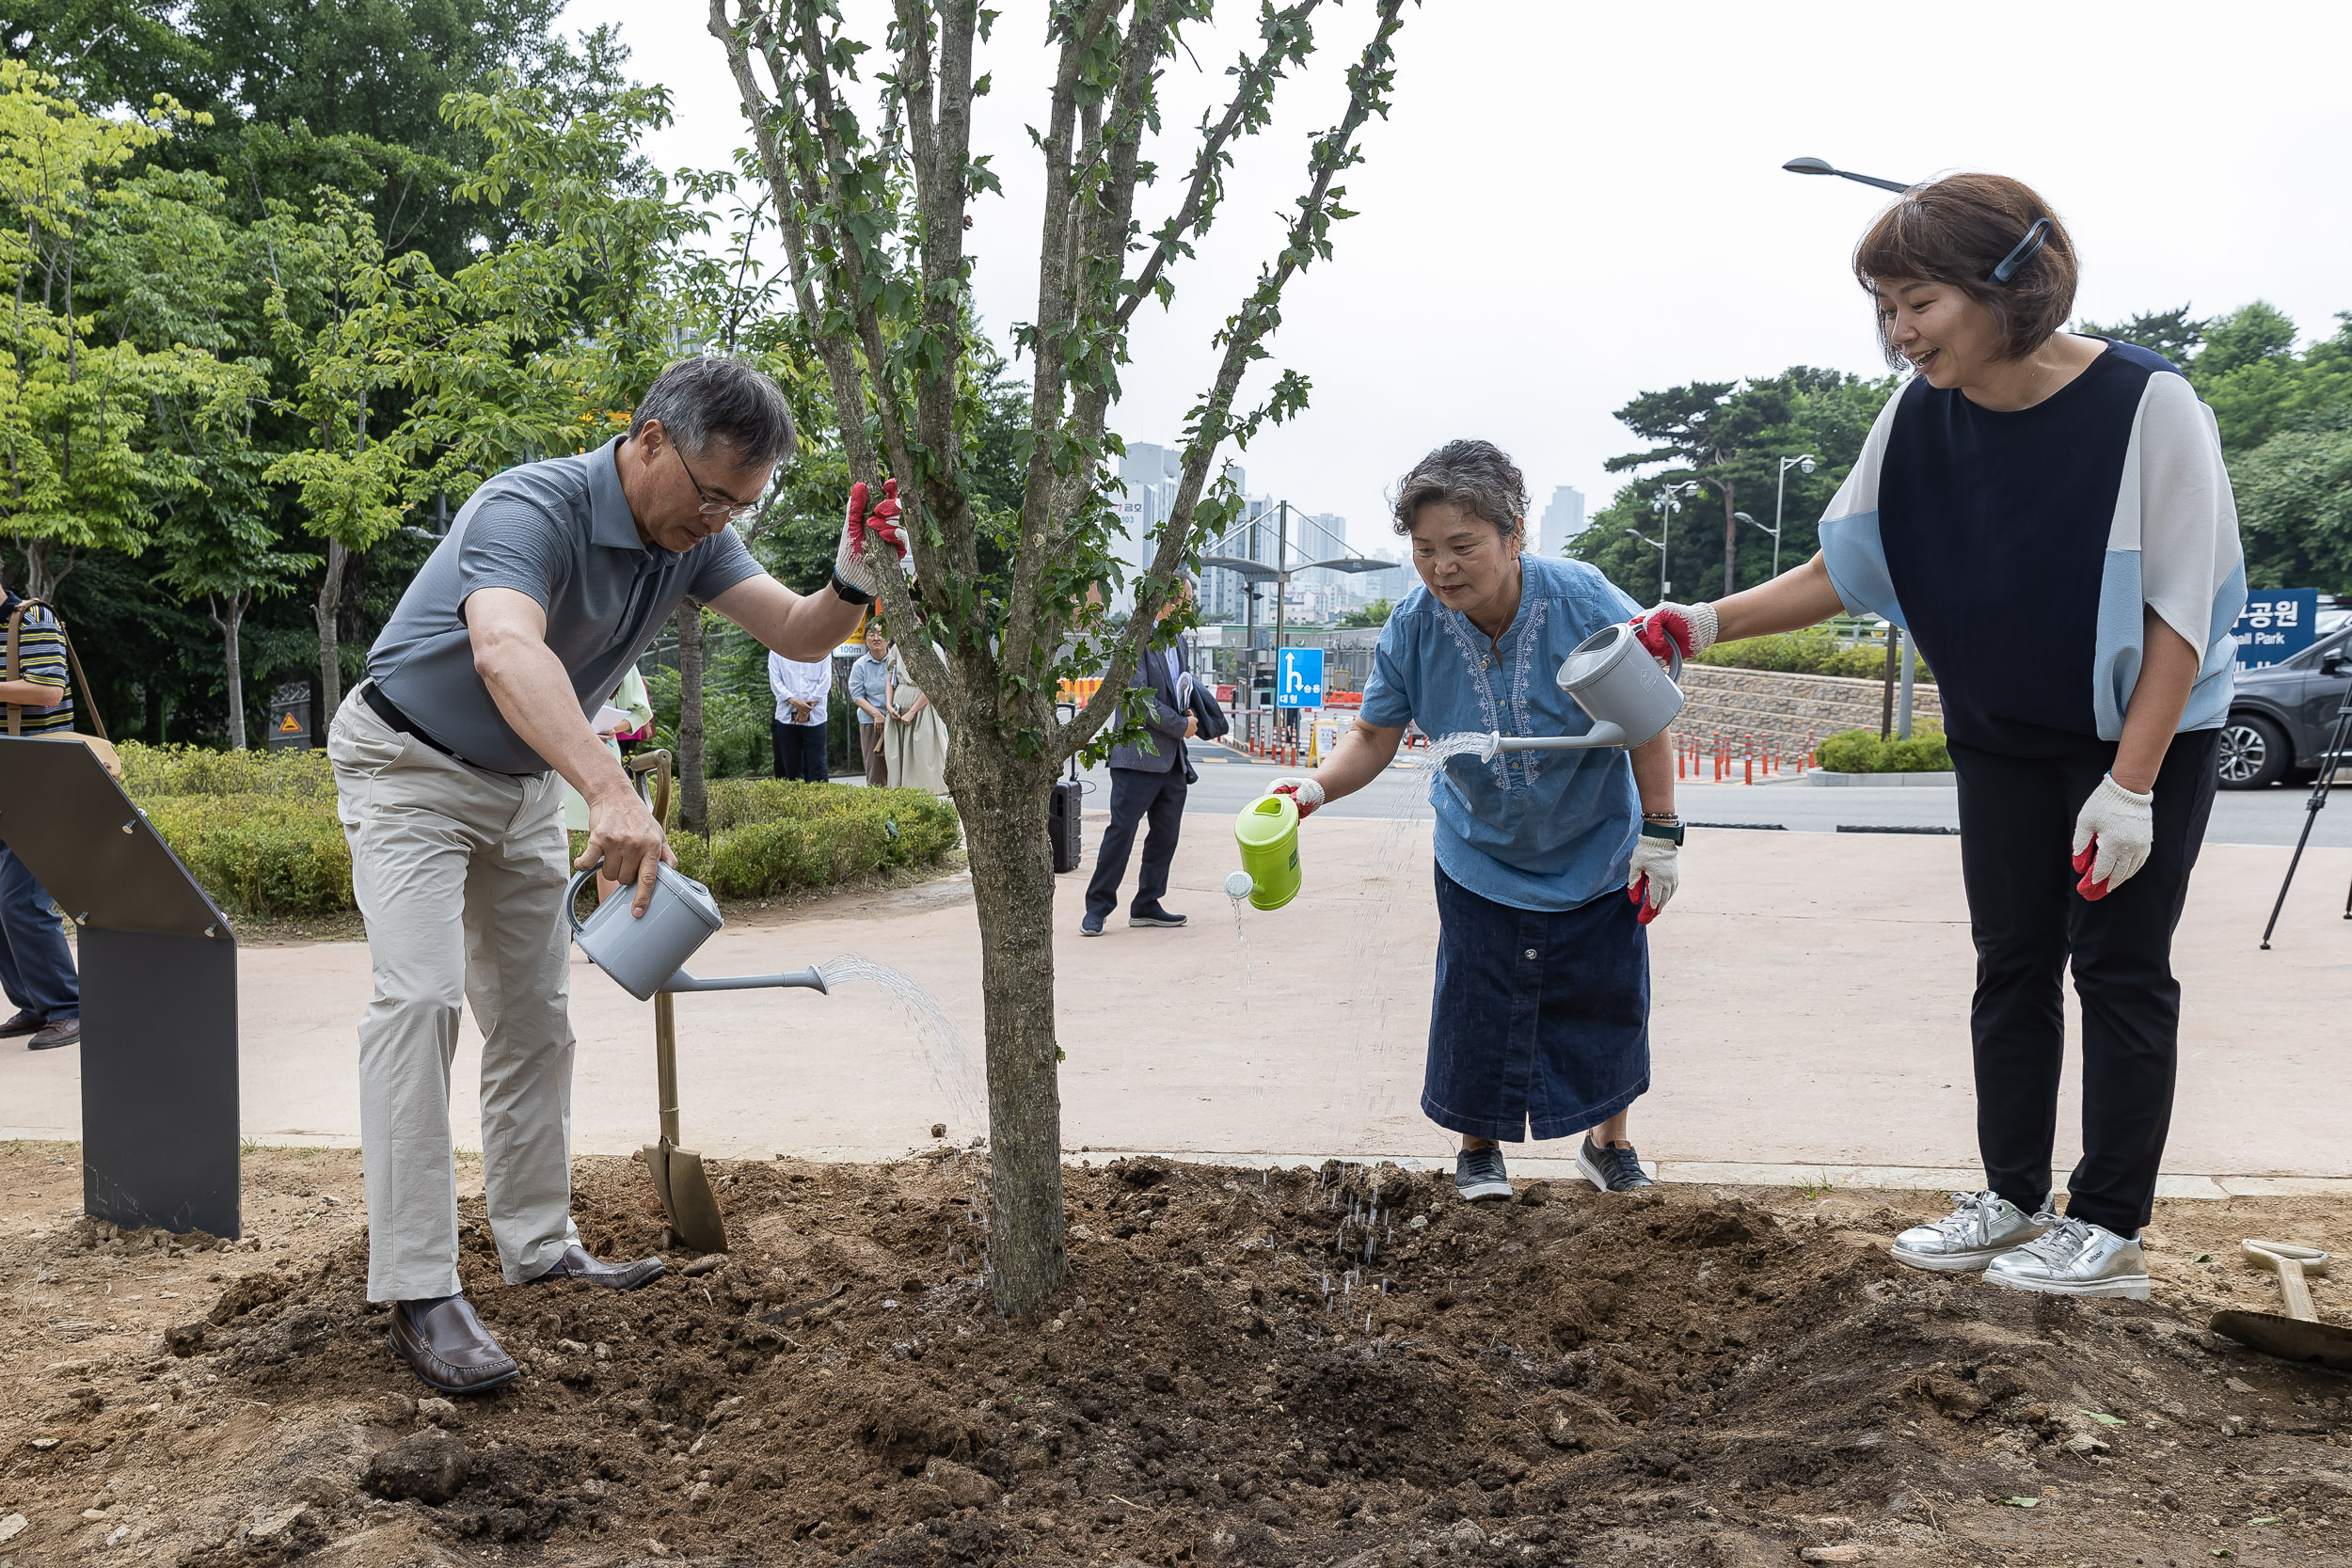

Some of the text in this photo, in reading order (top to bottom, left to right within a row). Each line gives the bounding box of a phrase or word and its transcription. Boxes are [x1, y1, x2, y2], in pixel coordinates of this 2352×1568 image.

[2254, 631, 2285, 645] Park
[840, 645, 862, 654] 100m
[1279, 693, 1298, 705] 대형
[2086, 1250, 2106, 1264] kitson
